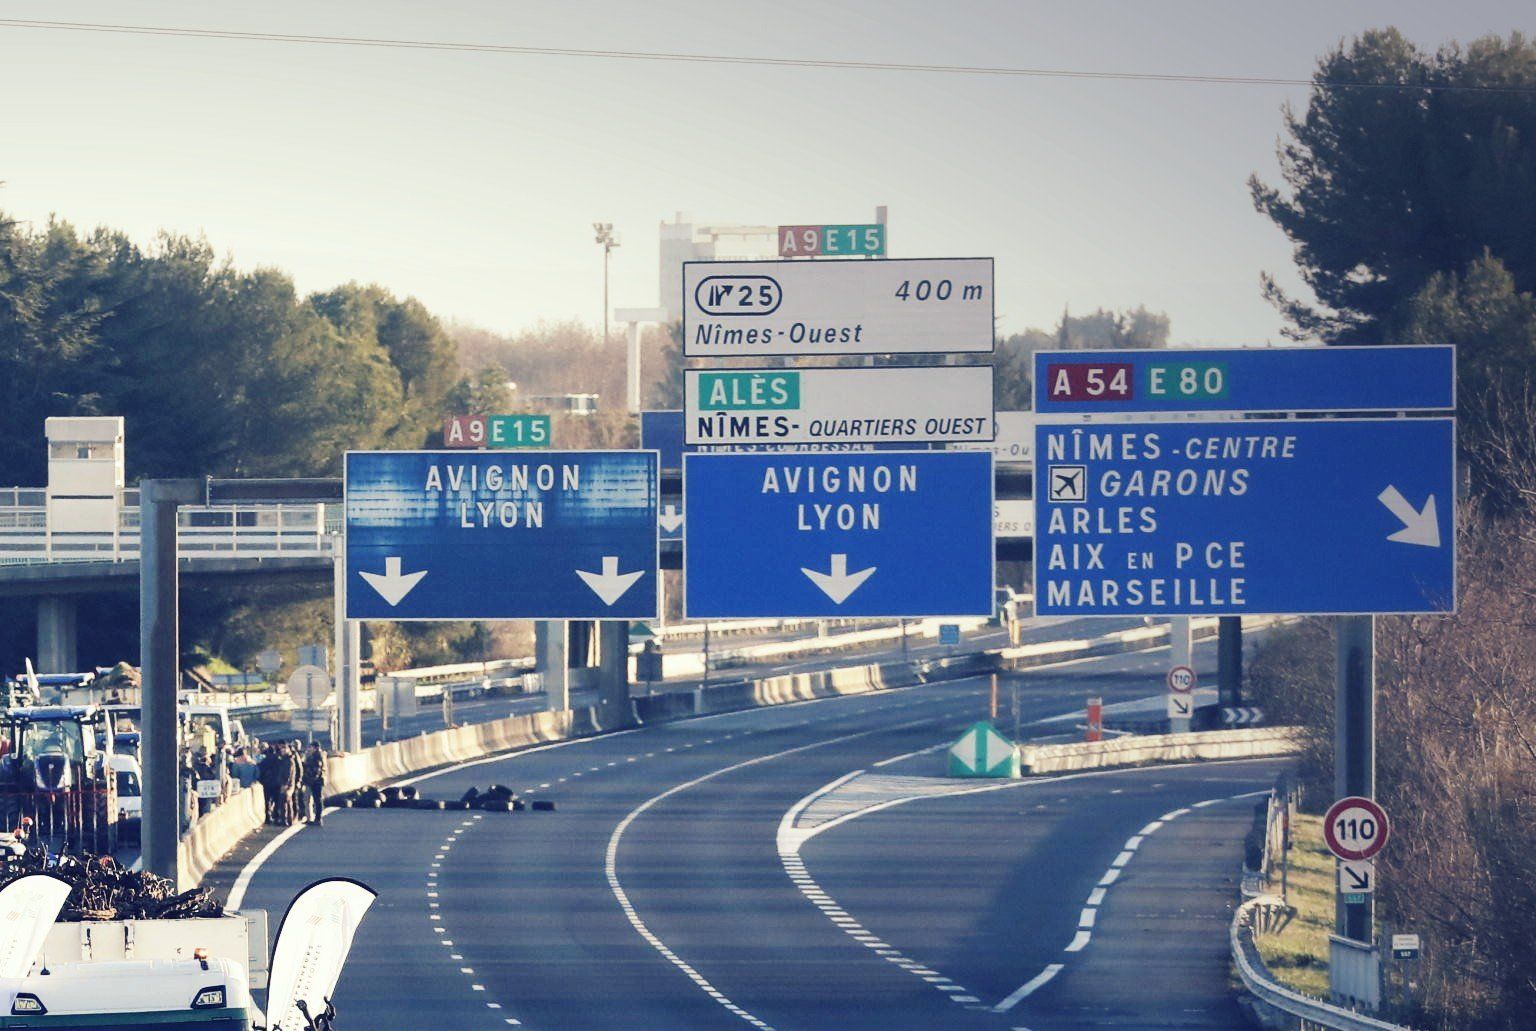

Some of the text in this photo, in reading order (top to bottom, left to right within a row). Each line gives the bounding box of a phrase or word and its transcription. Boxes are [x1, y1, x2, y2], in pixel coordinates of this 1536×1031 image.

[782, 228, 880, 252] A9 E15
[738, 279, 983, 307] 25 400 m
[695, 321, 863, 346] Nîmes-Ouest
[708, 374, 789, 406] ALÈS
[1086, 368, 1129, 396] 54
[1180, 367, 1224, 395] 80
[448, 418, 546, 444] A9 E15
[808, 418, 917, 437] QUARTIERS
[925, 417, 986, 435] OUEST
[425, 464, 581, 492] AVIGNON
[762, 465, 918, 494] AVIGNON
[1099, 468, 1251, 498] GARONS
[460, 501, 544, 529] LYON
[797, 503, 881, 532] LYON
[1048, 506, 1159, 535] ARLES
[1048, 543, 1105, 571] AIX
[1127, 551, 1155, 570] EN
[1047, 577, 1247, 608] MARSEILLE
[1174, 674, 1191, 686] 110
[1336, 817, 1376, 841] 110
